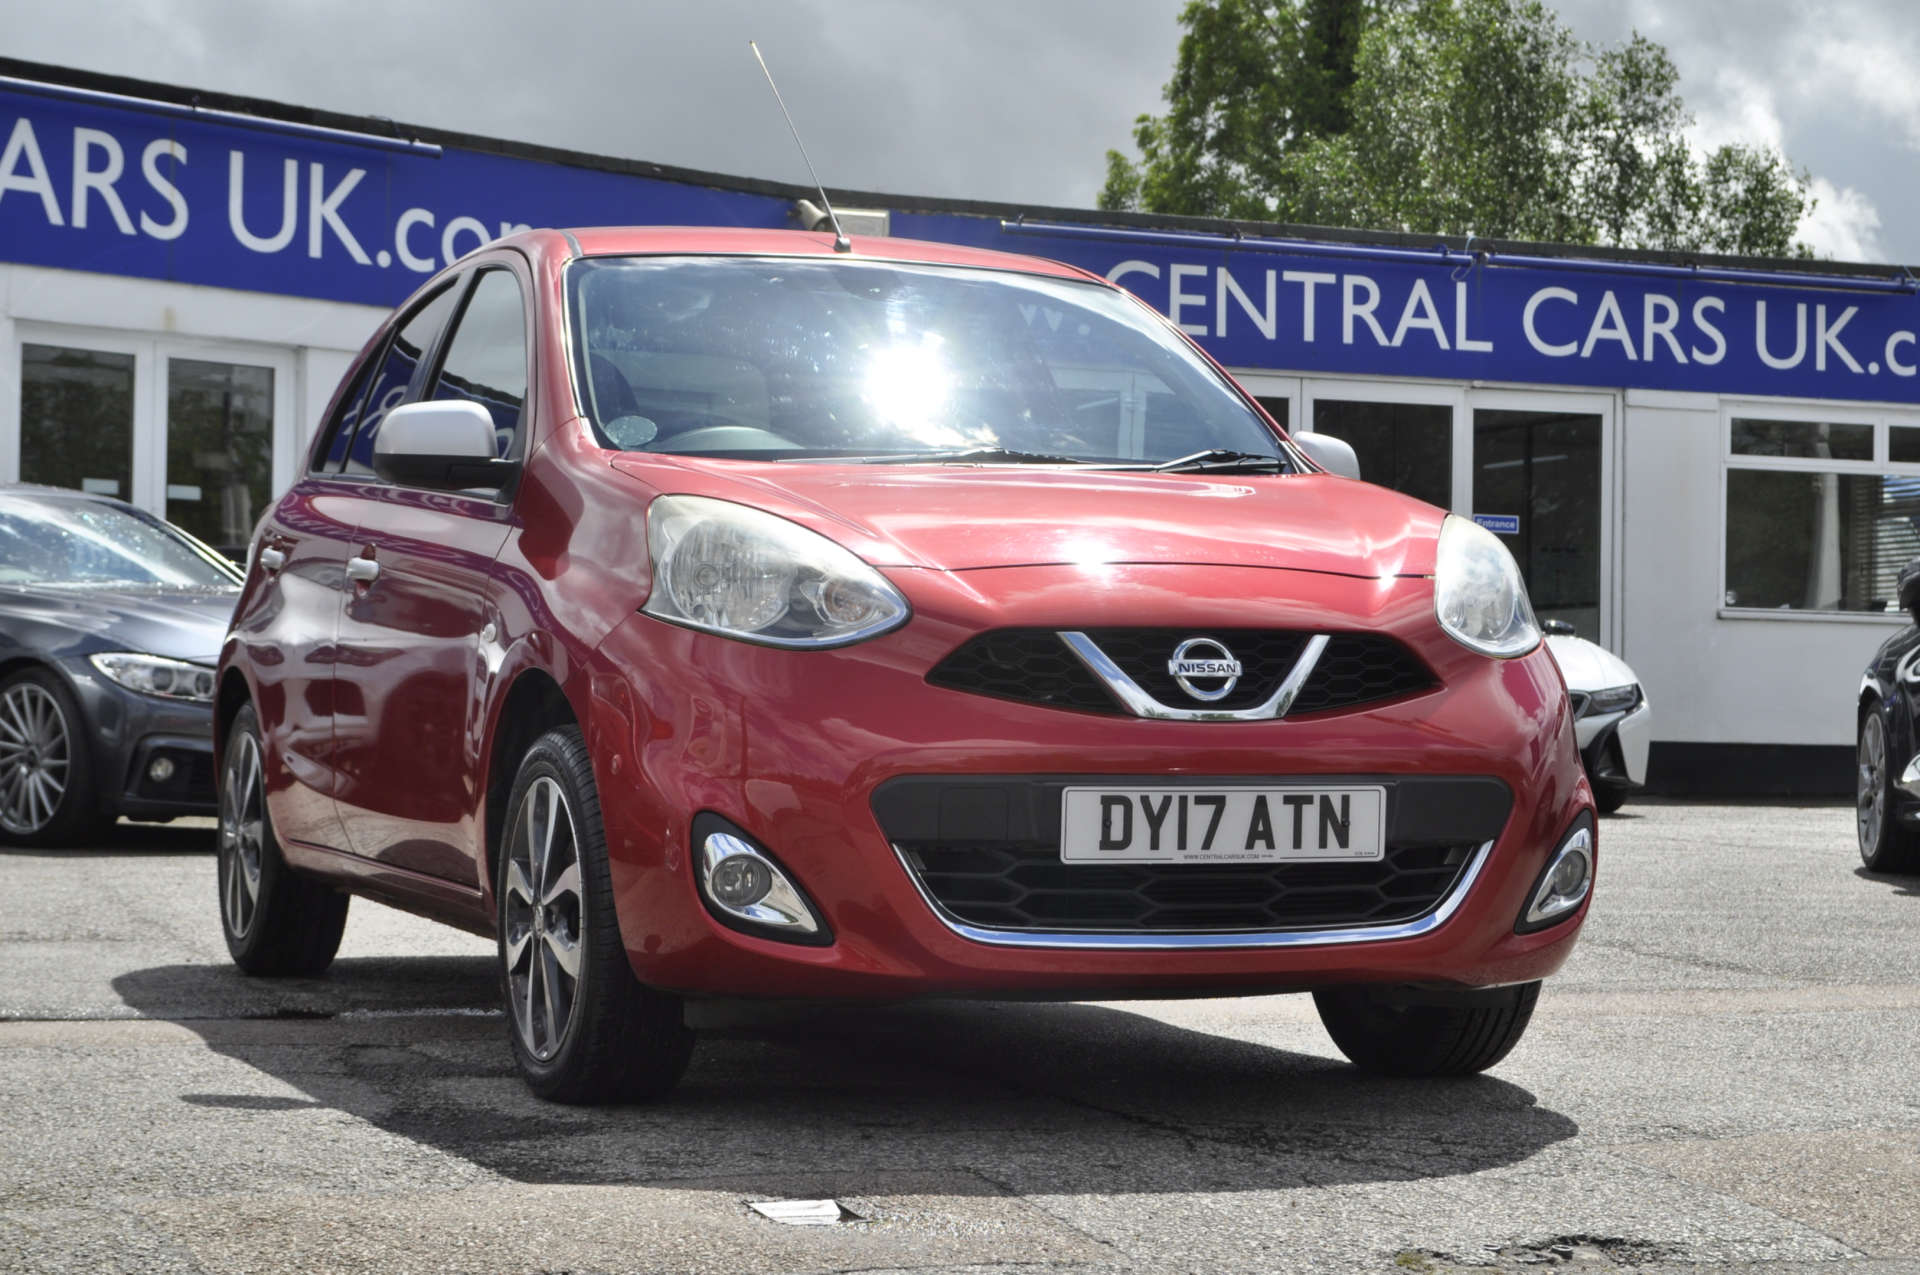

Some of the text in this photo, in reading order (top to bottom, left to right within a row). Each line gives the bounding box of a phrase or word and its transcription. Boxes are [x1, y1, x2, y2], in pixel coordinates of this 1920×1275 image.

[1522, 286, 1727, 366] CARS
[1755, 300, 1917, 377] UK.c
[1477, 518, 1515, 529] Entrance
[1178, 663, 1237, 673] NISSAN
[1099, 794, 1351, 852] DY17 ATN
